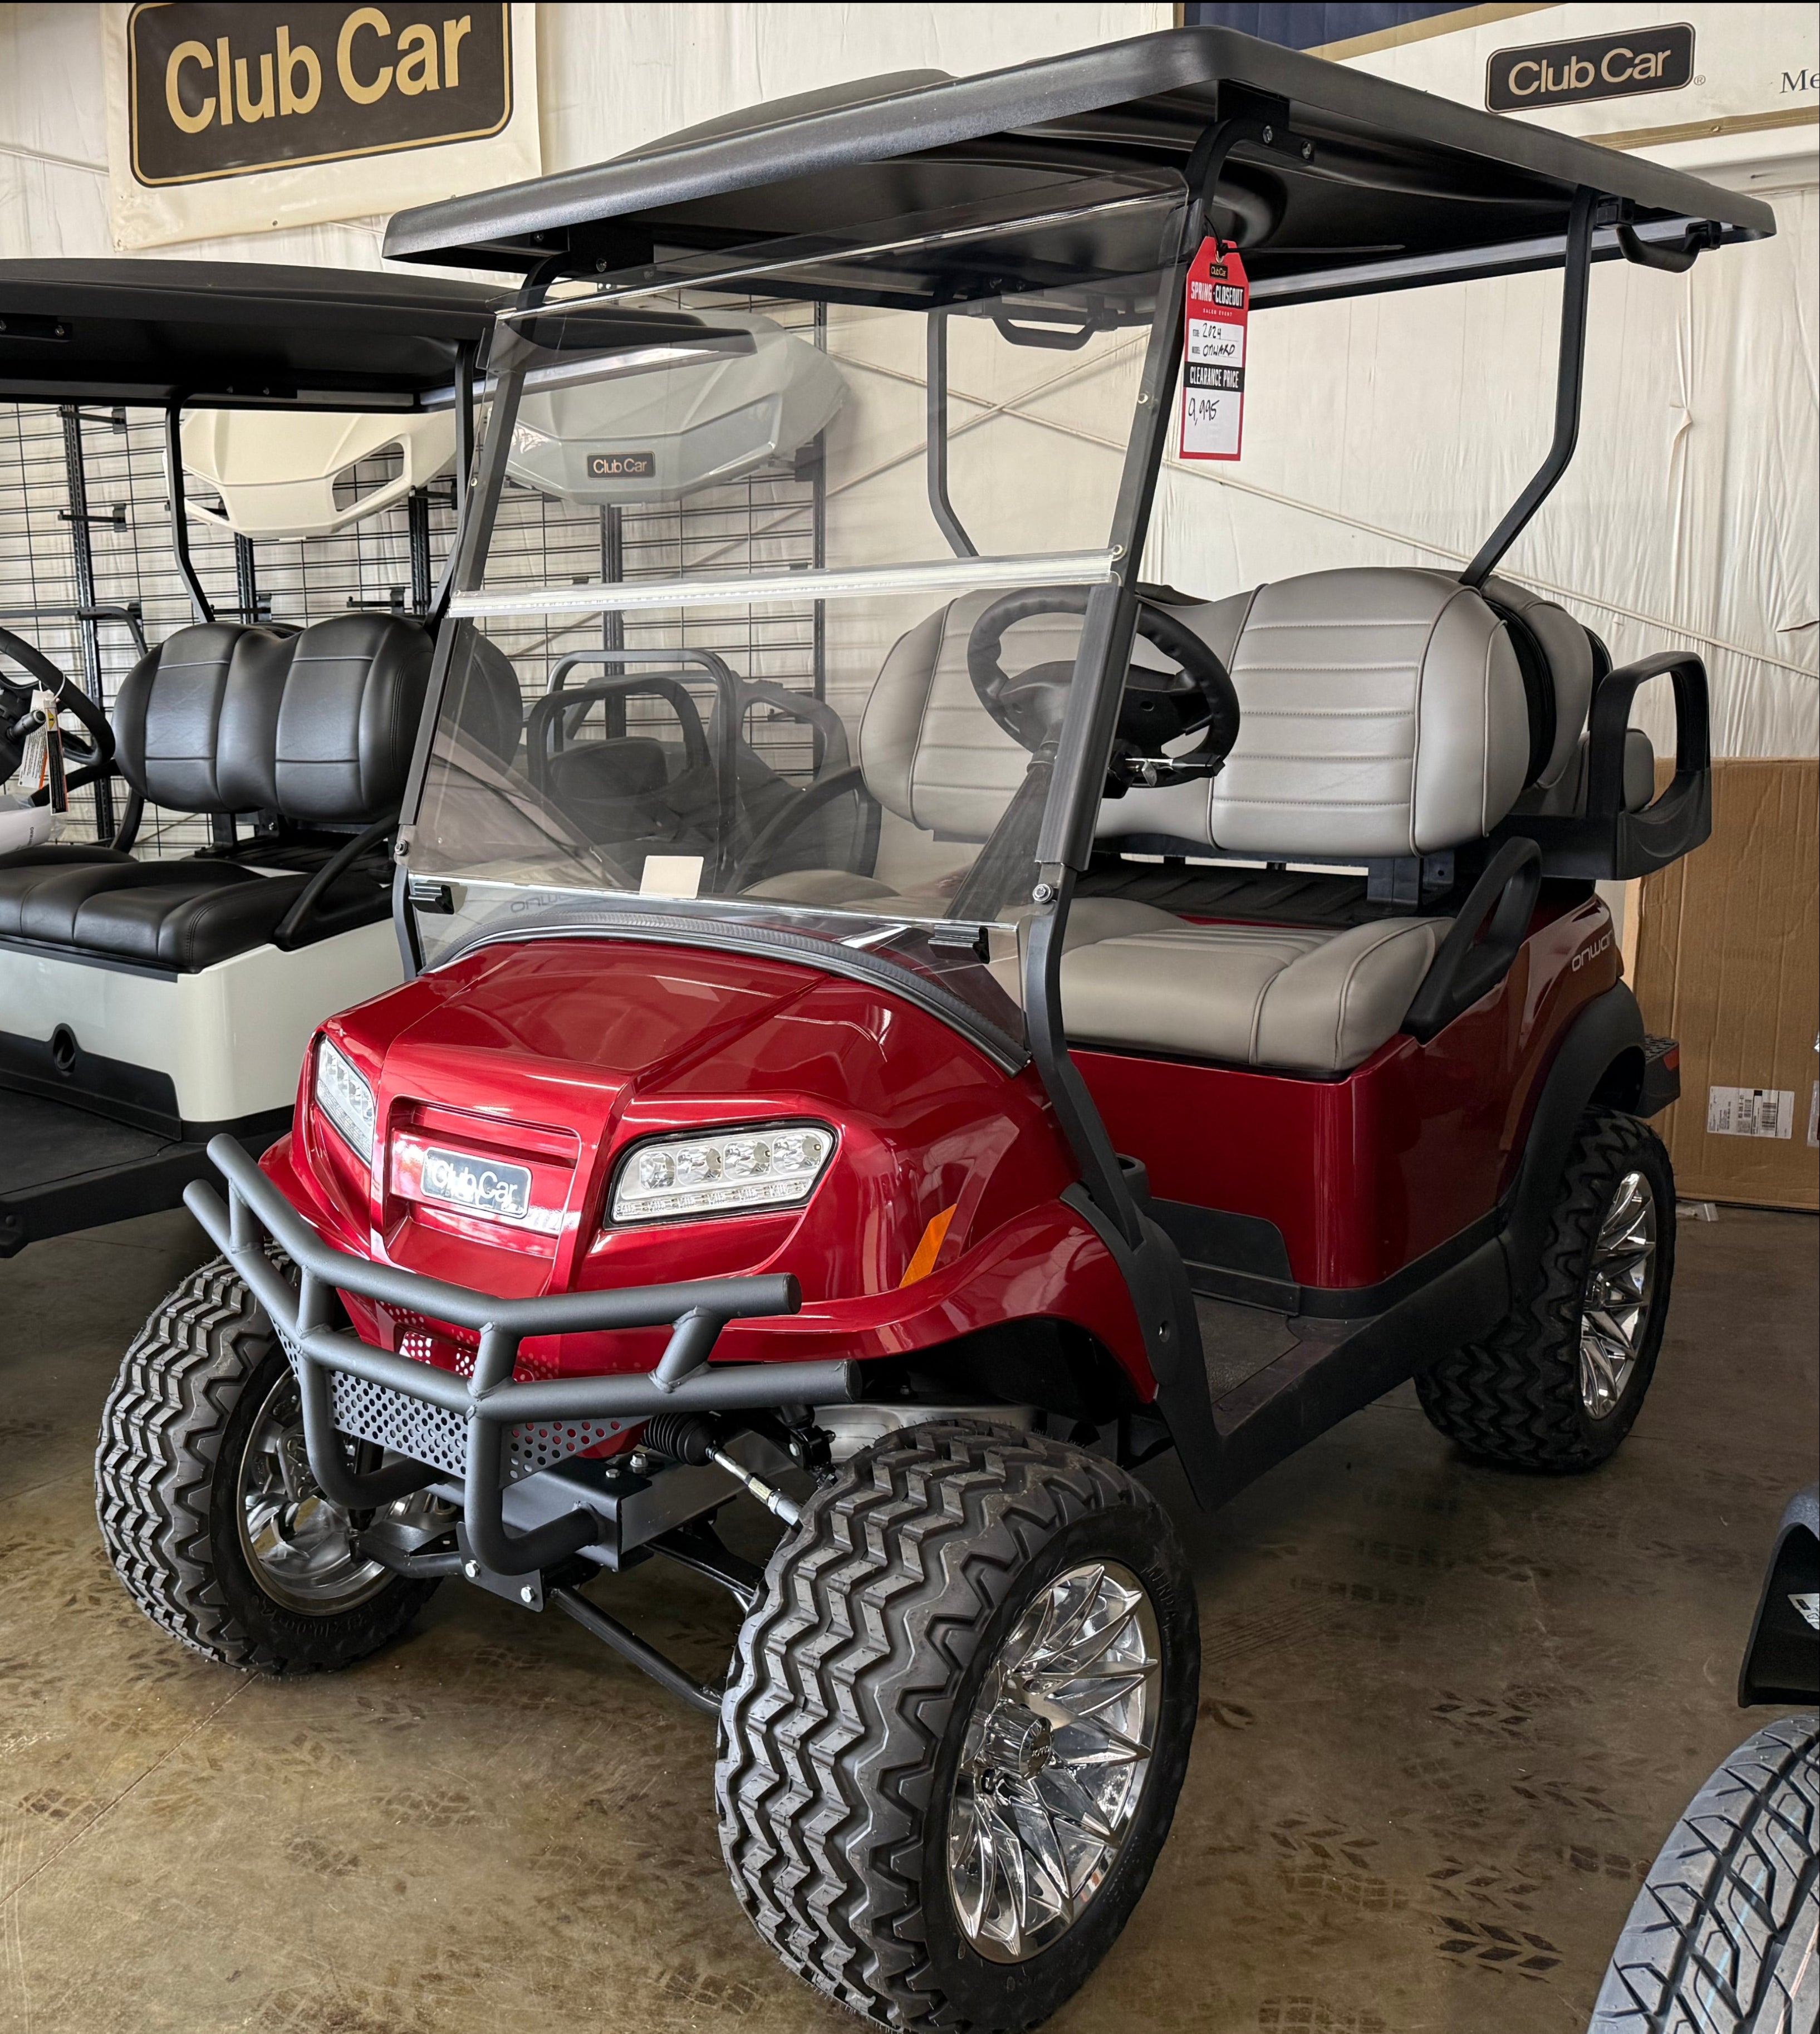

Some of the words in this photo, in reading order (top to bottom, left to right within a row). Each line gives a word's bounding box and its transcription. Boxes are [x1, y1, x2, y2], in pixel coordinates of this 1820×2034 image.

[166, 25, 322, 134] Club
[337, 7, 471, 105] Car
[1508, 56, 1595, 95] Club
[1601, 48, 1671, 83] Car
[1191, 281, 1212, 302] SPRING
[1215, 285, 1244, 307] CLOSEOUT
[1203, 322, 1221, 339] 2024
[1190, 366, 1221, 386] CLEARANCE
[1223, 370, 1239, 388] PRICE
[1188, 397, 1220, 426] 9,995
[593, 459, 622, 474] Club
[624, 458, 647, 472] Car
